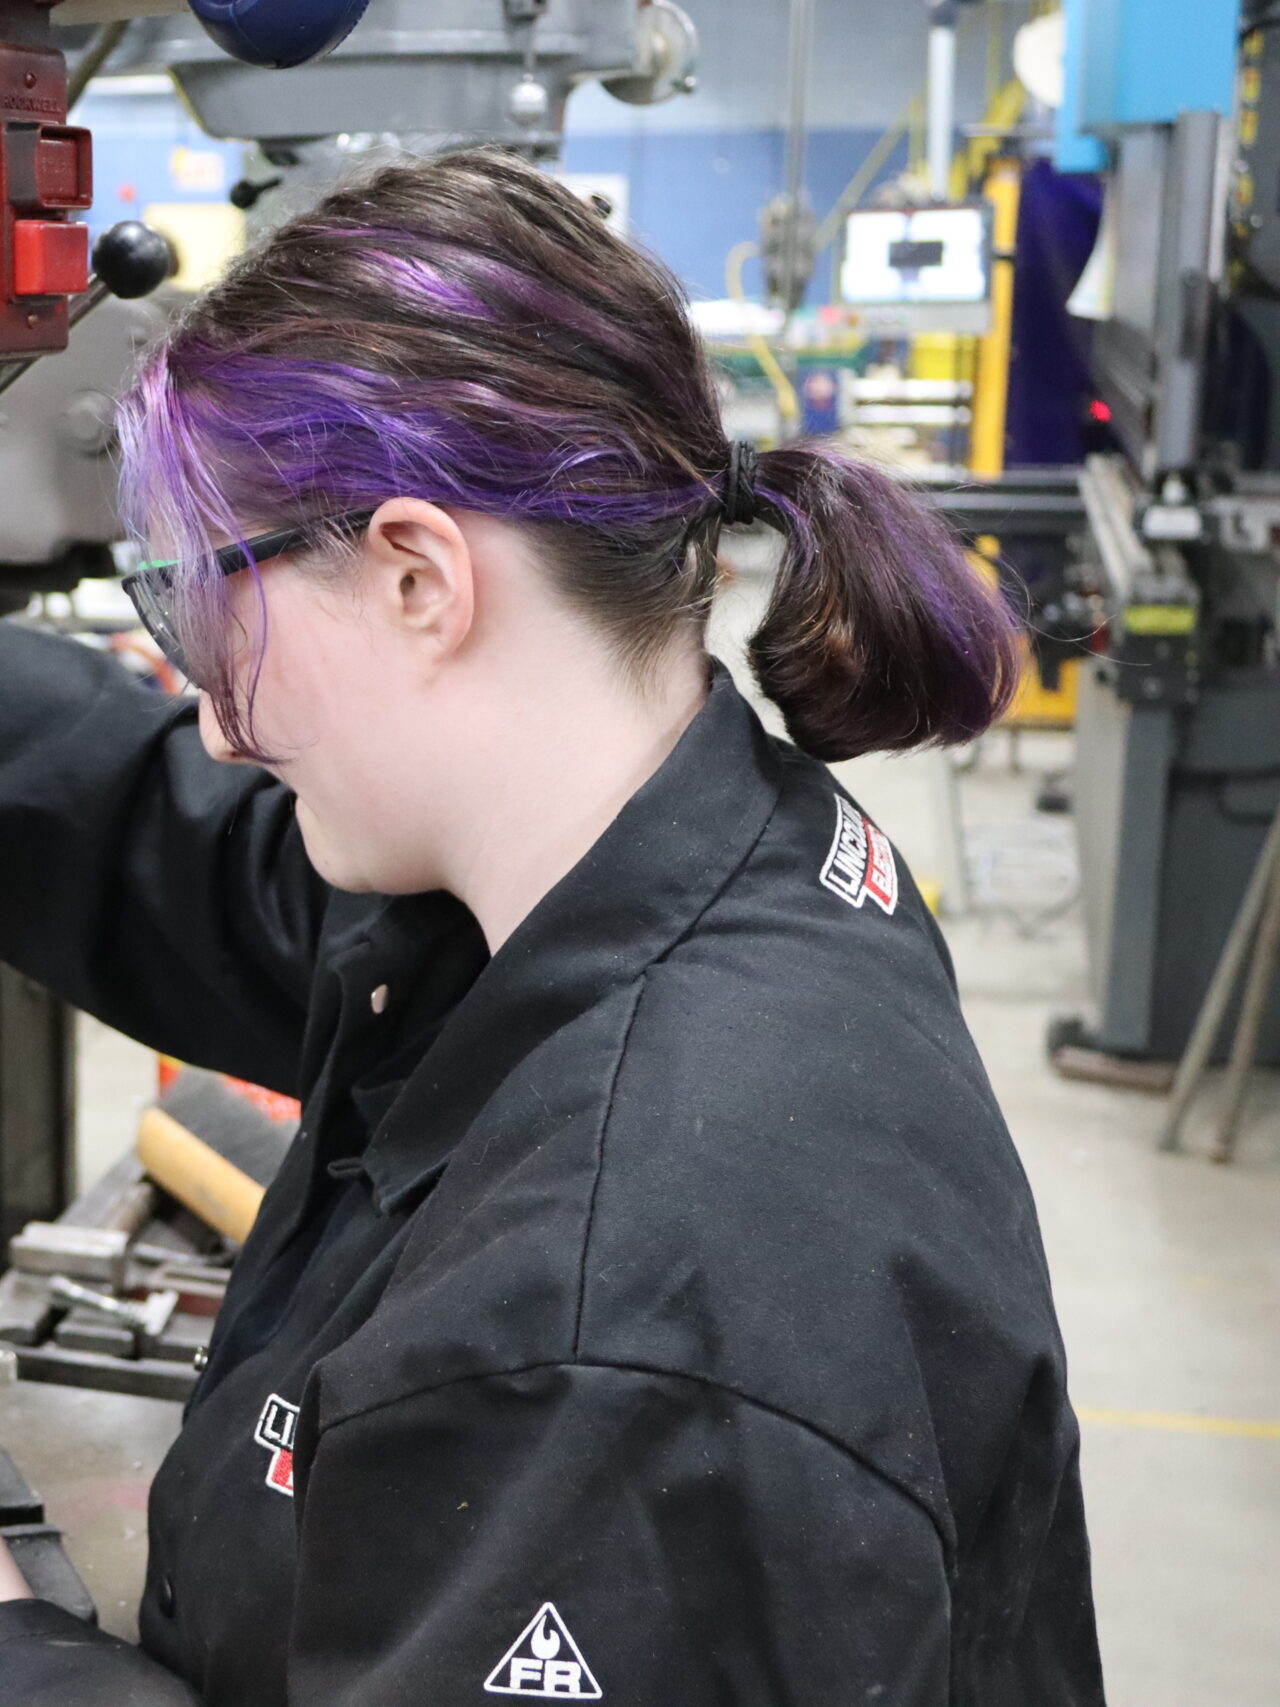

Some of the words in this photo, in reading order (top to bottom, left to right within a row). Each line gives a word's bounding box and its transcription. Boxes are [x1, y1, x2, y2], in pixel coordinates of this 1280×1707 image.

[1, 96, 62, 114] ROCKWELL
[263, 1403, 295, 1448] LI
[509, 1657, 582, 1693] FR
